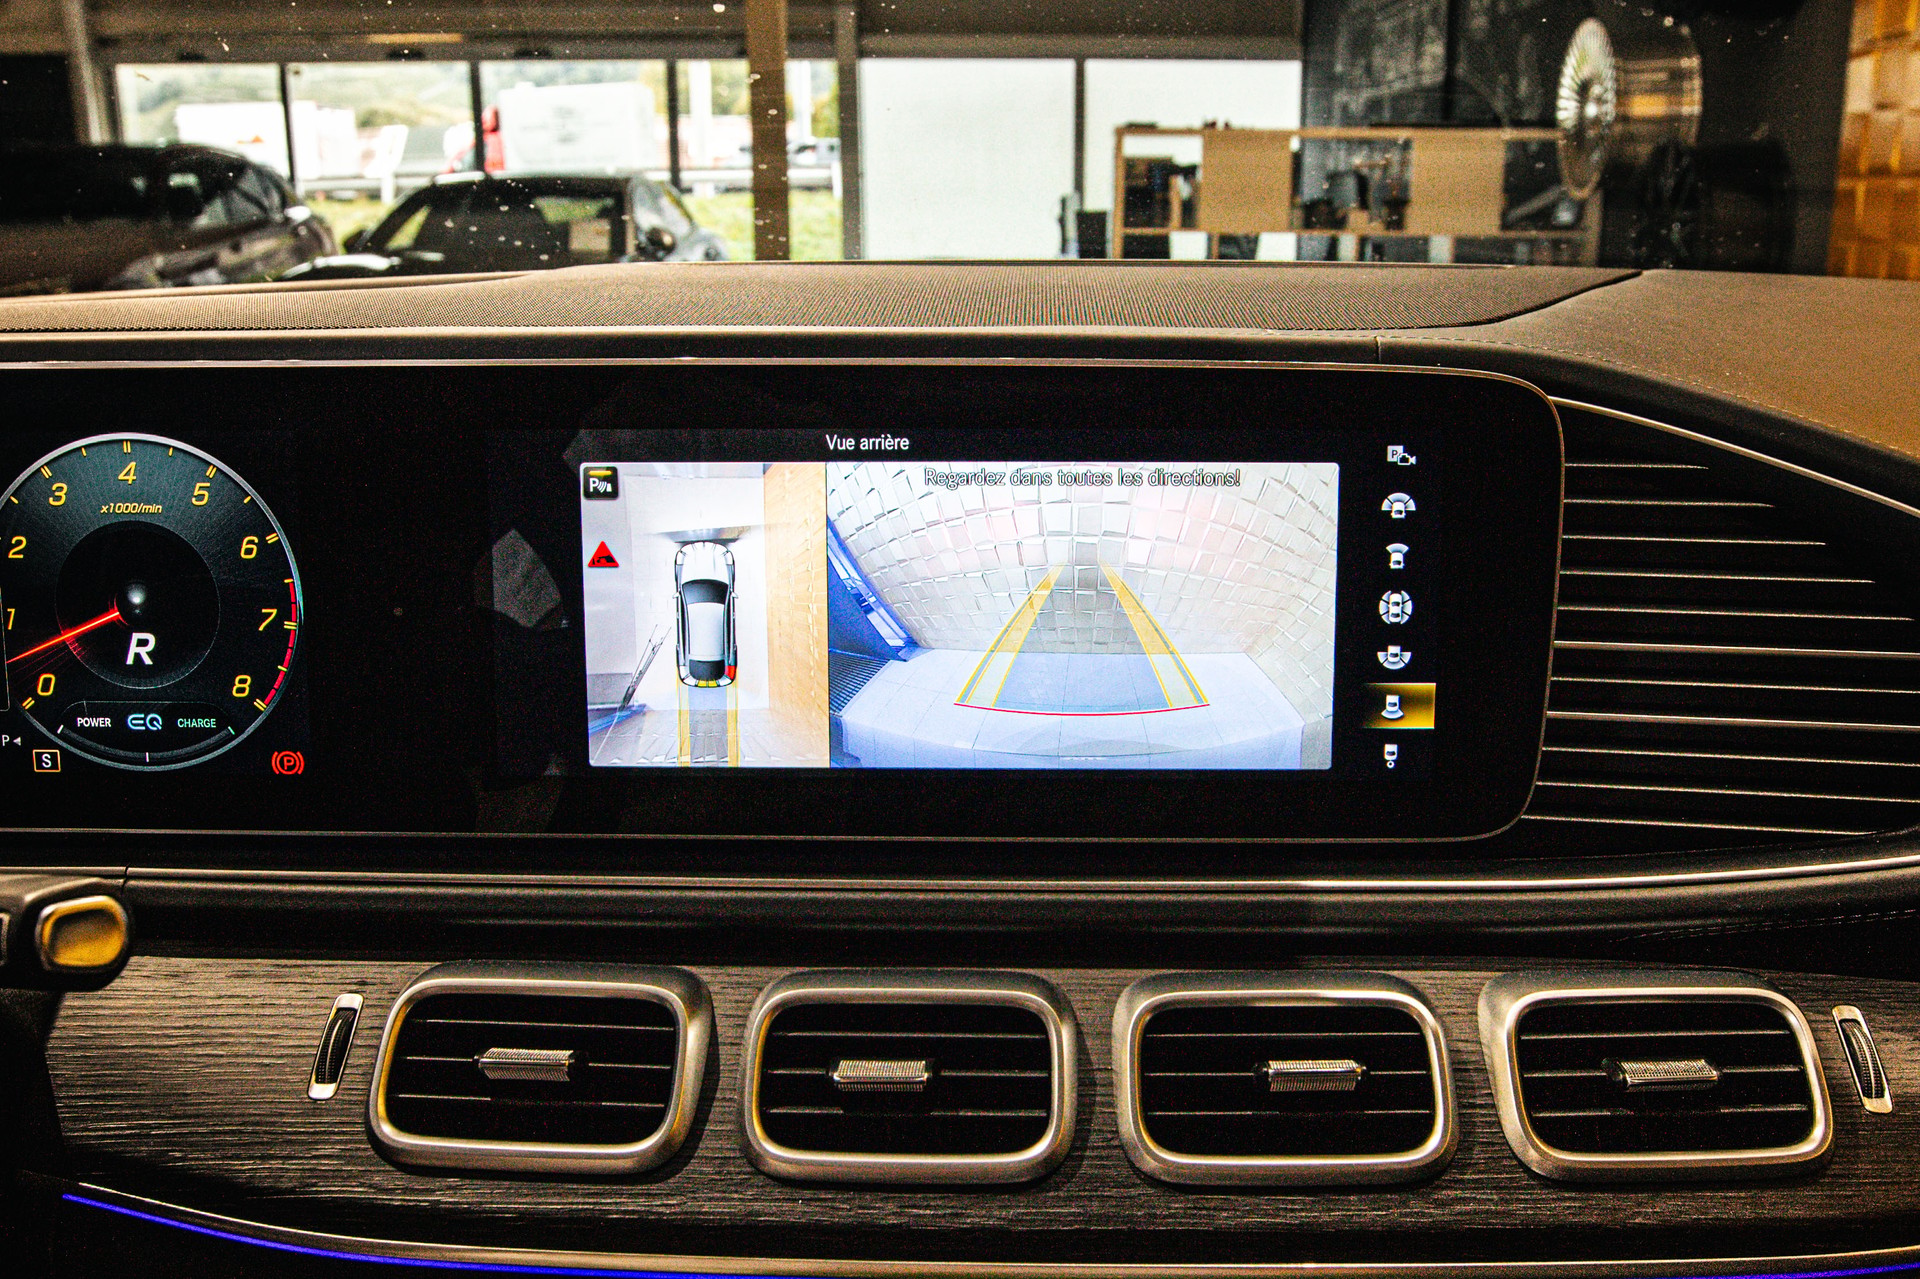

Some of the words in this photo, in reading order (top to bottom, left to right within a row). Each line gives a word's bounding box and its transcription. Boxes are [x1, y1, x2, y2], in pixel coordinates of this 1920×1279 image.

[825, 434, 855, 450] Vue
[859, 434, 910, 450] arrière
[118, 461, 137, 484] 4
[924, 467, 1006, 491] Regardez
[1009, 468, 1053, 487] dans
[1057, 469, 1114, 487] toutes
[1117, 467, 1144, 487] les
[1147, 467, 1242, 487] directions!
[48, 482, 68, 506] 3
[191, 482, 211, 506] 5
[100, 502, 163, 515] x1000/min
[8, 535, 27, 559] 2
[240, 535, 259, 559] 6
[7, 607, 16, 631] 1
[258, 608, 277, 631] 7
[125, 632, 156, 665] R
[37, 673, 56, 696] 0
[232, 674, 251, 697] 8
[76, 716, 112, 728] POWER
[127, 713, 163, 731] EQ
[177, 717, 217, 729] CHARGE
[1, 735, 10, 747] P
[41, 753, 51, 768] S
